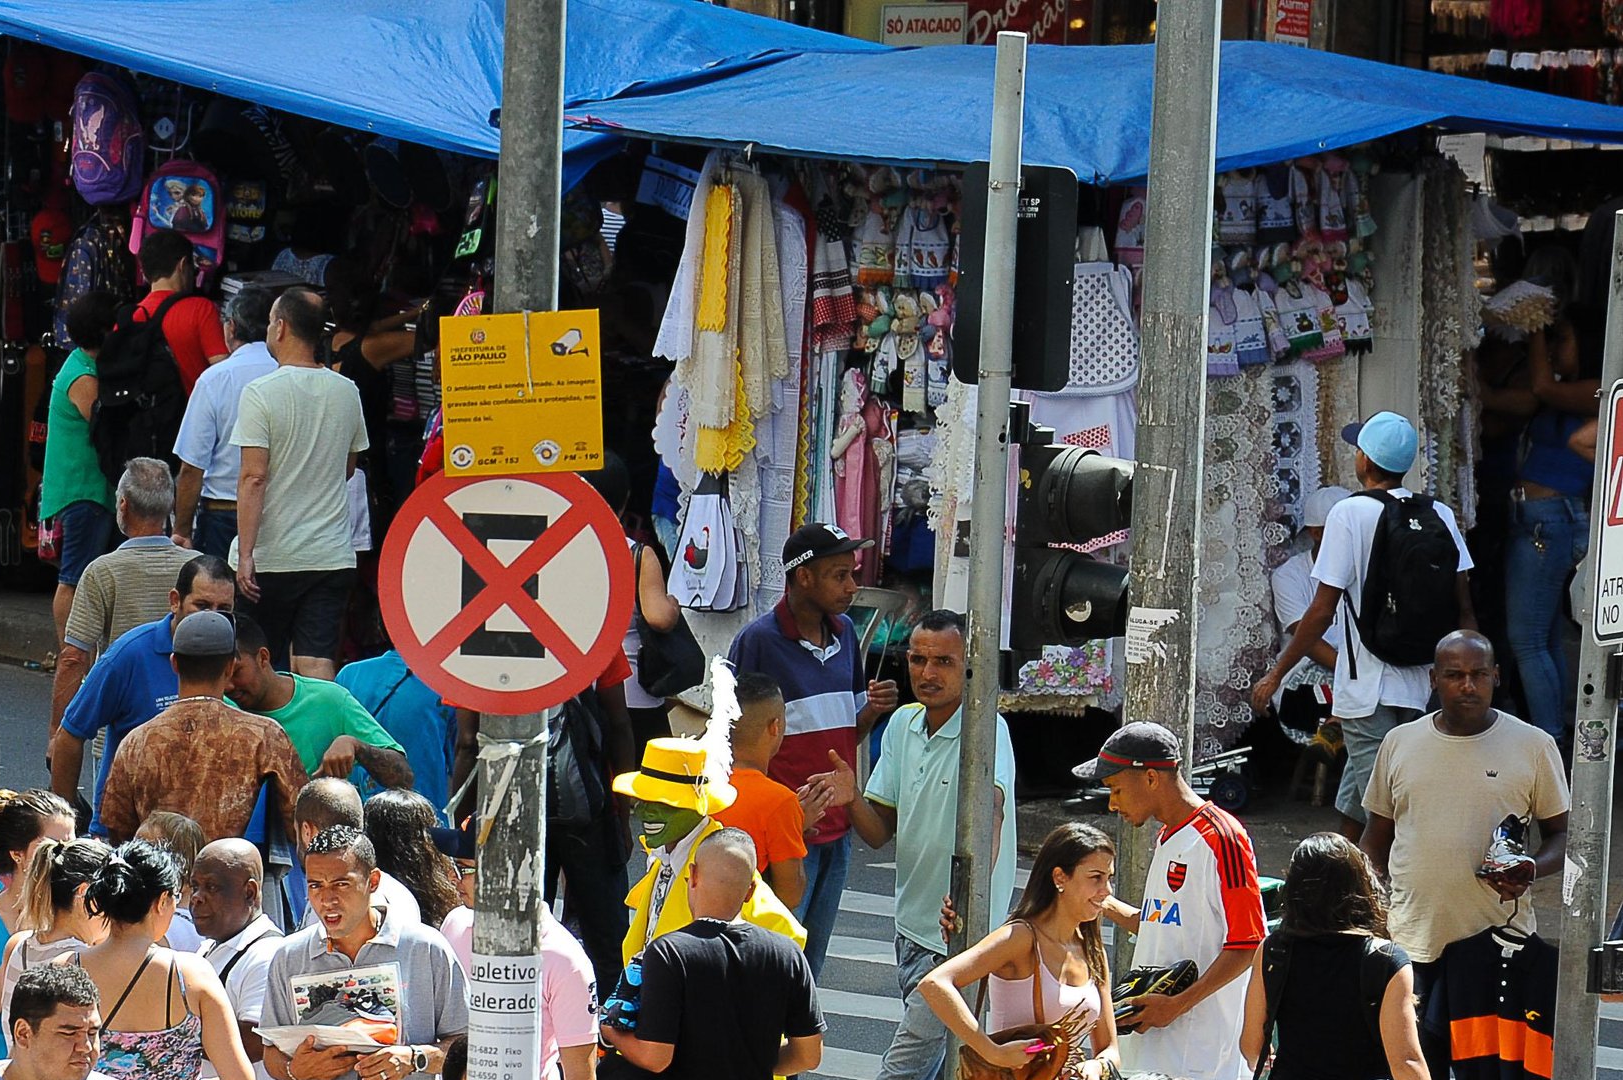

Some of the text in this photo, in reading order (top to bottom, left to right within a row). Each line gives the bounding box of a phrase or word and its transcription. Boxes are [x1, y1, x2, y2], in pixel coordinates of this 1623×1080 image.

[887, 14, 962, 34] SÓ ATACADO
[450, 351, 507, 362] SÃO PAULO
[446, 385, 453, 393] O
[1602, 604, 1620, 626] NO
[505, 1047, 522, 1056] Fixo
[505, 1061, 523, 1069] vivo
[503, 1073, 513, 1080] Oi
